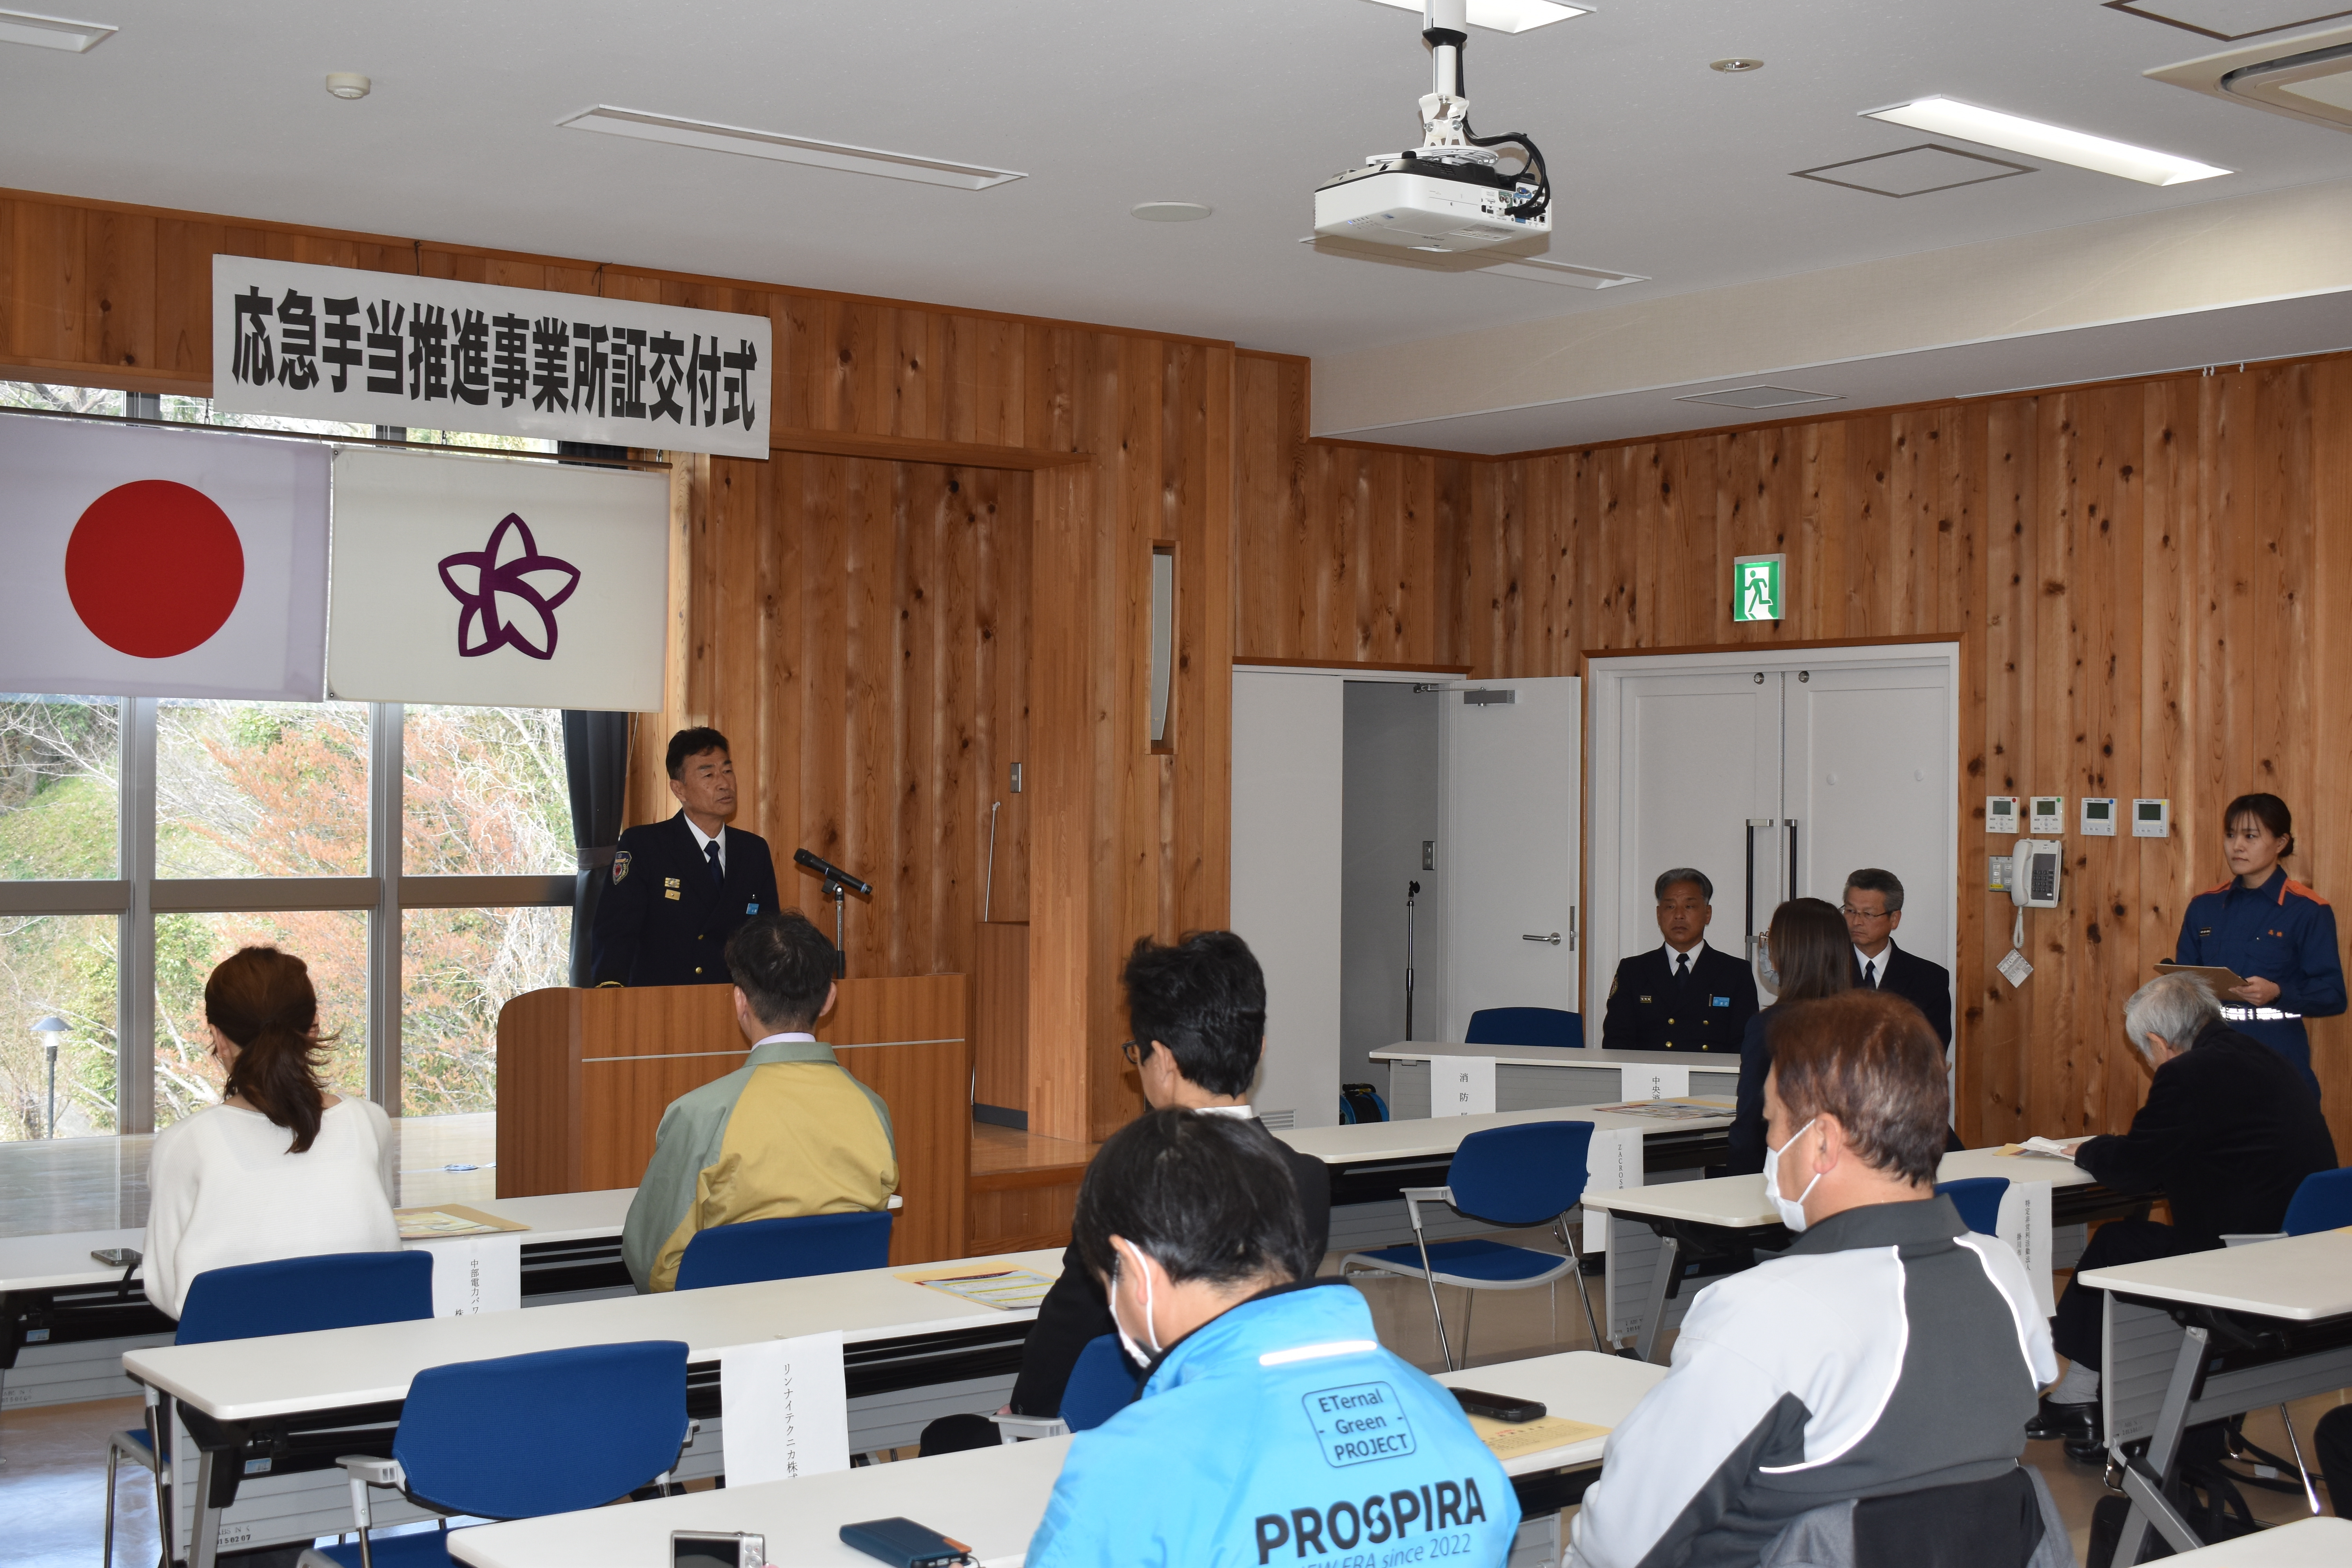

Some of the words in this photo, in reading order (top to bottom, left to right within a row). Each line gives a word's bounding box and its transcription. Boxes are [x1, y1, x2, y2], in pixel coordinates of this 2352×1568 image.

[232, 285, 757, 432] 応急手当推進事業所証交付式
[1459, 1073, 1469, 1116] 消防
[470, 1259, 479, 1314] 中部電力パワ
[1318, 1388, 1384, 1413] ETernal
[1335, 1416, 1387, 1434] Green
[1334, 1433, 1408, 1461] PROJECT
[1255, 1477, 1487, 1565] PROSPIRA
[1382, 1545, 1424, 1568] since
[1429, 1533, 1471, 1558] 2022
